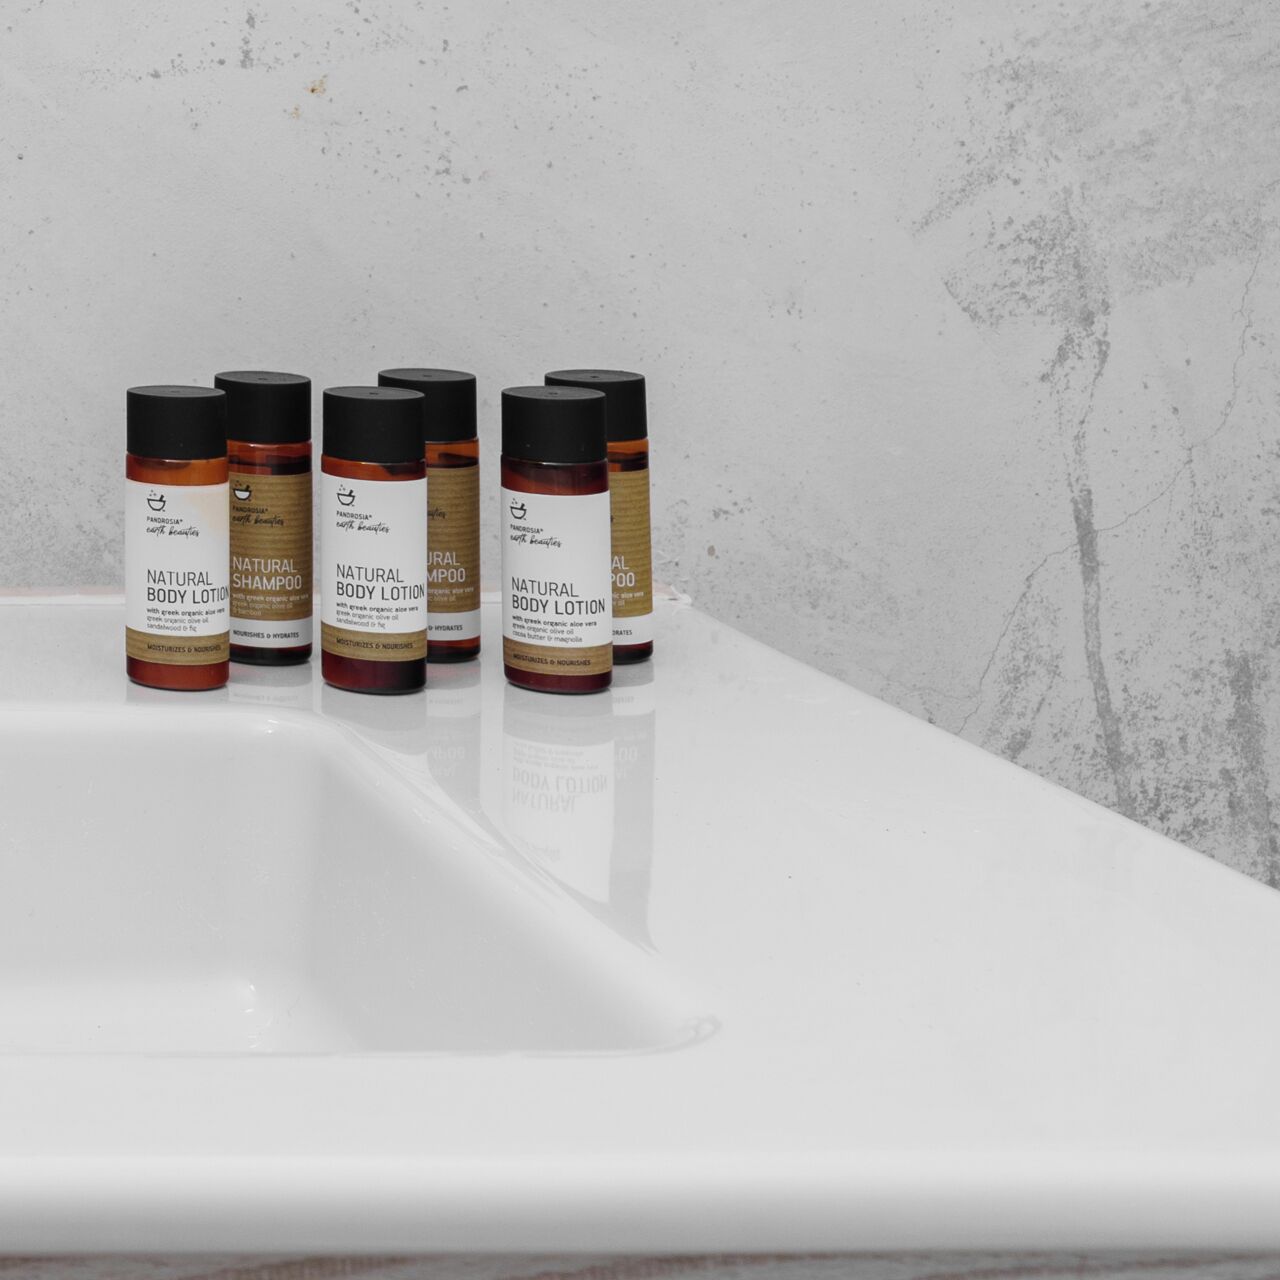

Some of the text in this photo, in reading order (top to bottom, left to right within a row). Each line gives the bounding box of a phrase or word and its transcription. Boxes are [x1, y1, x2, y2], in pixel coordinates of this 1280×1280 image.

[232, 514, 251, 526] earth
[146, 525, 200, 539] earth beauties
[336, 520, 390, 535] earth beauties
[510, 533, 561, 548] earth beauties
[232, 556, 298, 573] NATURAL
[427, 551, 461, 566] URAL
[147, 569, 213, 586] NATURAL
[336, 563, 404, 583] NATURAL
[427, 568, 466, 583] MPOO
[232, 573, 302, 590] SHAMPOO
[512, 576, 579, 597] NATURAL
[147, 586, 229, 604] BODY LOTION
[336, 581, 425, 601] BODY LOTION
[146, 607, 160, 615] with
[349, 604, 368, 612] greek
[369, 606, 393, 614] organic
[512, 594, 605, 615] BODY LOTION
[336, 609, 351, 617] greek
[352, 612, 374, 620] organic
[146, 623, 181, 631] sandalwood
[336, 617, 370, 627] sandalwood
[378, 621, 386, 629] fig
[526, 625, 548, 633] organic
[543, 619, 568, 627] organic
[233, 629, 265, 638] NOURISHES
[512, 630, 526, 638] cocoa
[527, 632, 546, 640] butter
[147, 643, 186, 652] MOISTURIZES
[336, 637, 374, 648] MOISTURIZES
[382, 642, 413, 650] NOURISHES
[556, 658, 592, 666] NOURISHES
